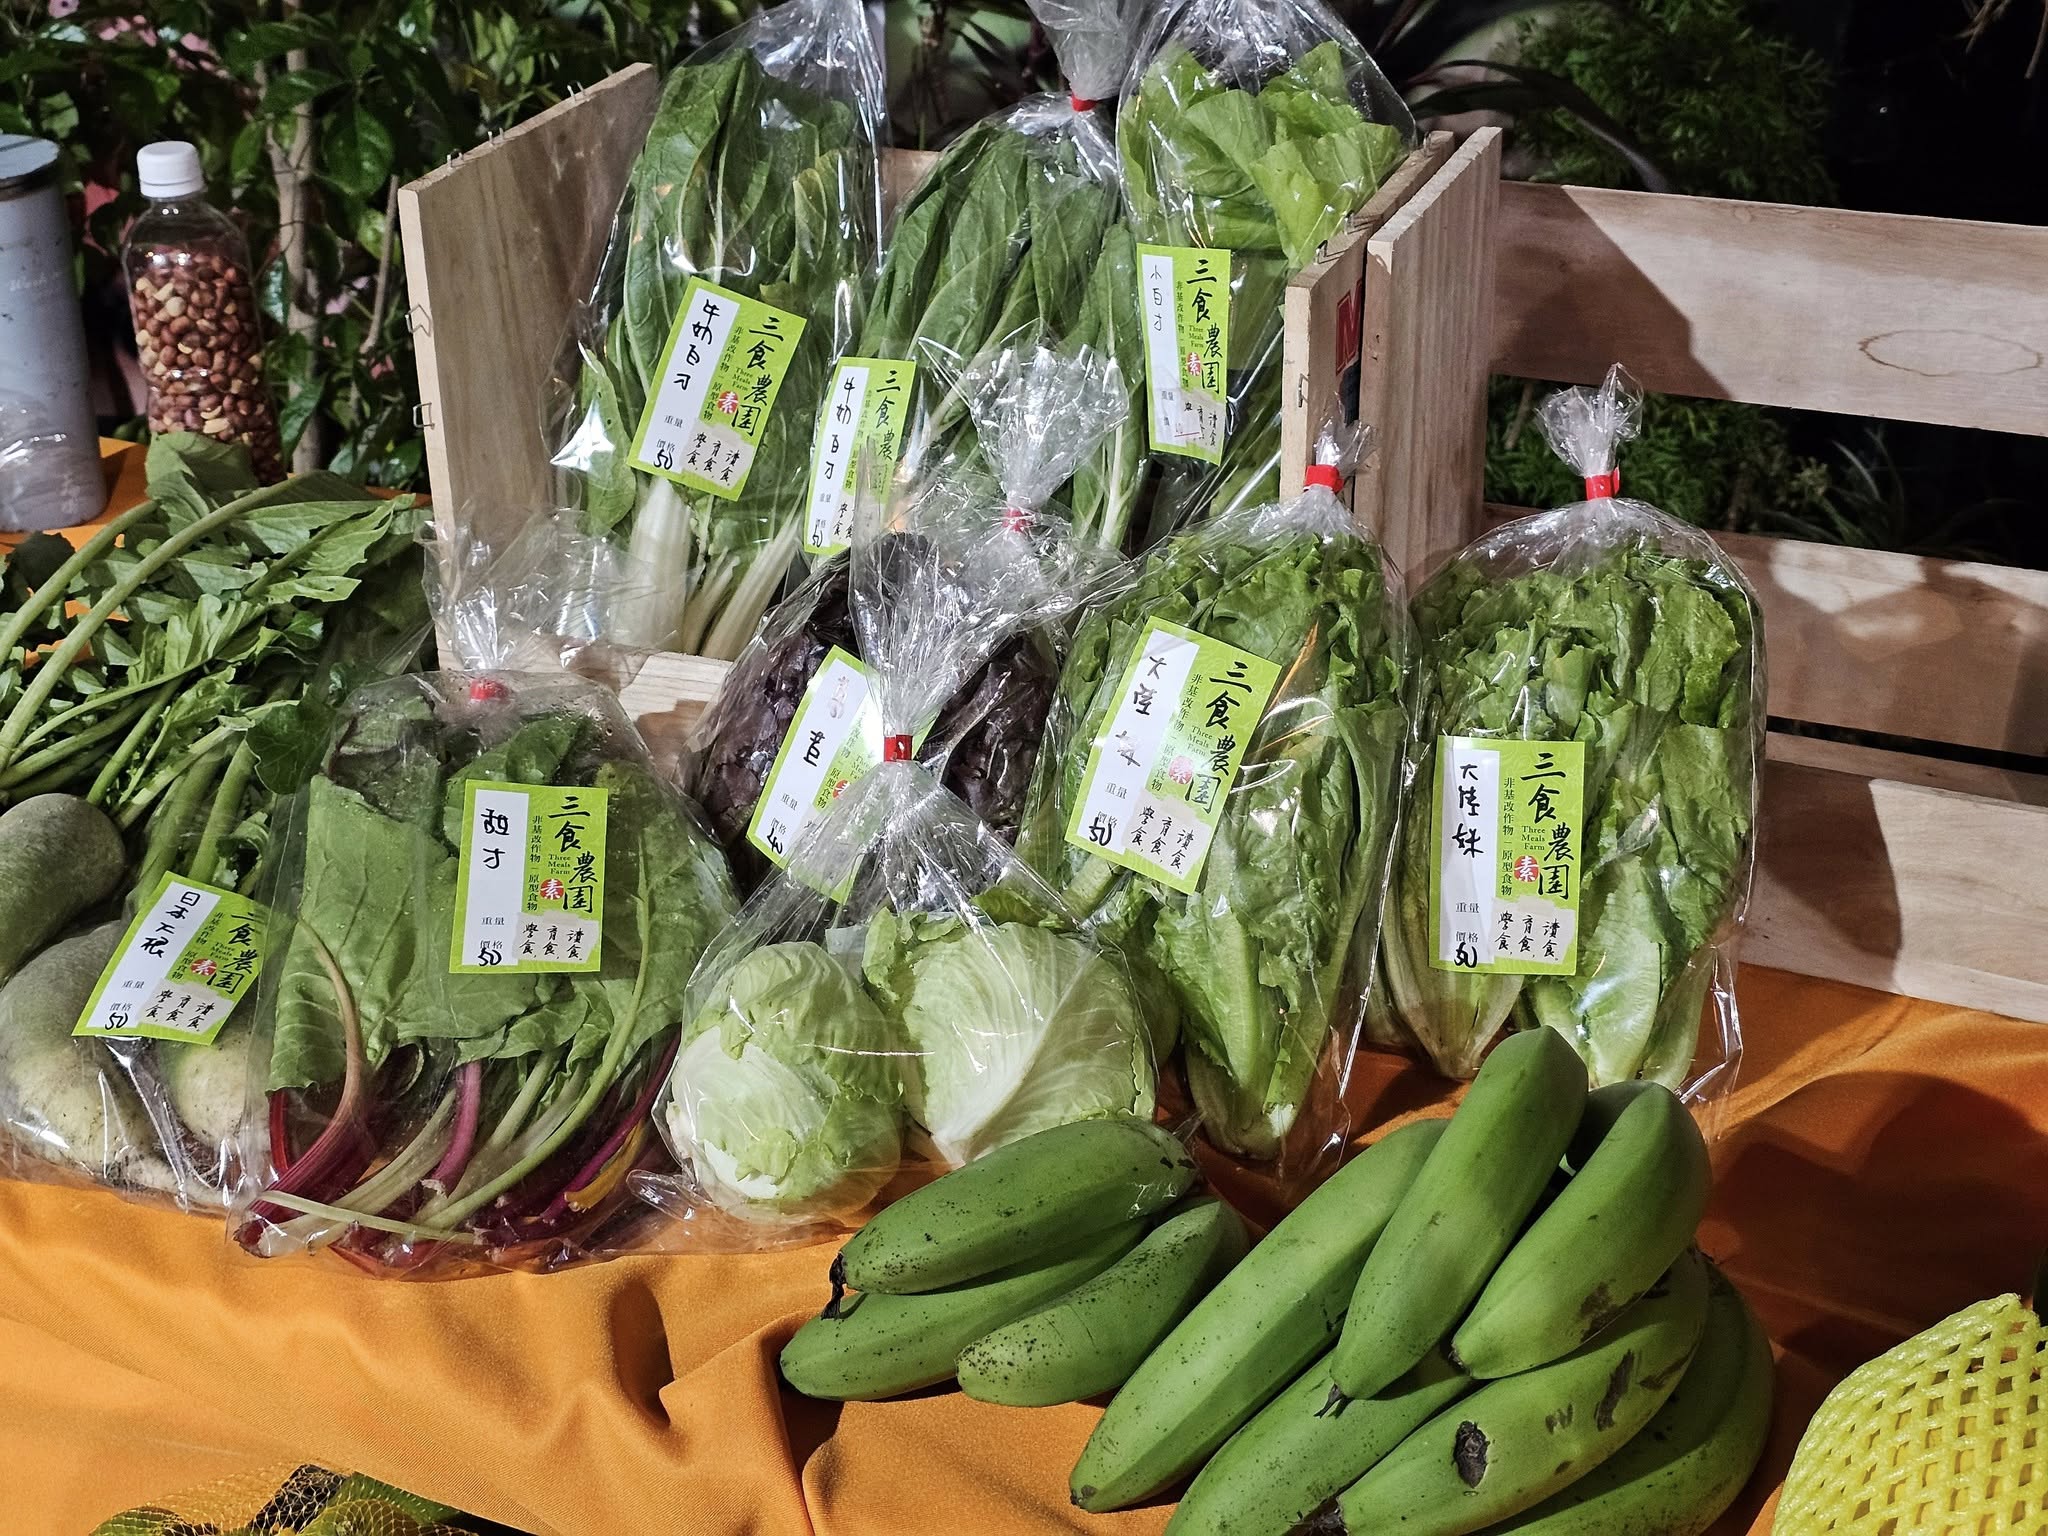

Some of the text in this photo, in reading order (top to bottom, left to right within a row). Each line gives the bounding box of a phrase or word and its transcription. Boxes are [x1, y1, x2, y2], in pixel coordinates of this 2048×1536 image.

[1186, 259, 1223, 394] 三食農園
[736, 367, 754, 379] Three
[1187, 353, 1201, 377] 素
[732, 316, 784, 437] 三食農園
[718, 391, 739, 414] 素
[1185, 661, 1253, 814] 三食農園
[1187, 734, 1210, 749] Meals
[1191, 725, 1213, 741] Three
[1104, 781, 1128, 800] 重量
[782, 793, 798, 811] 重量
[1520, 752, 1575, 900] 三食農園
[1522, 825, 1546, 834] Three
[1521, 834, 1545, 842] Meals
[1524, 842, 1545, 851] Farm
[548, 796, 598, 914] 三食農園
[549, 853, 571, 861] Three
[548, 861, 571, 869] Meals
[550, 868, 571, 876] Farm
[1514, 855, 1540, 883] 素
[540, 878, 564, 900] 素
[1455, 902, 1480, 914] 重量
[481, 916, 505, 926] 重量
[480, 940, 503, 950] 價格
[1455, 931, 1479, 943] 價格
[206, 911, 267, 995] 三食農園
[478, 948, 502, 967] 50
[190, 958, 217, 976] 素
[104, 1012, 128, 1030] 50
